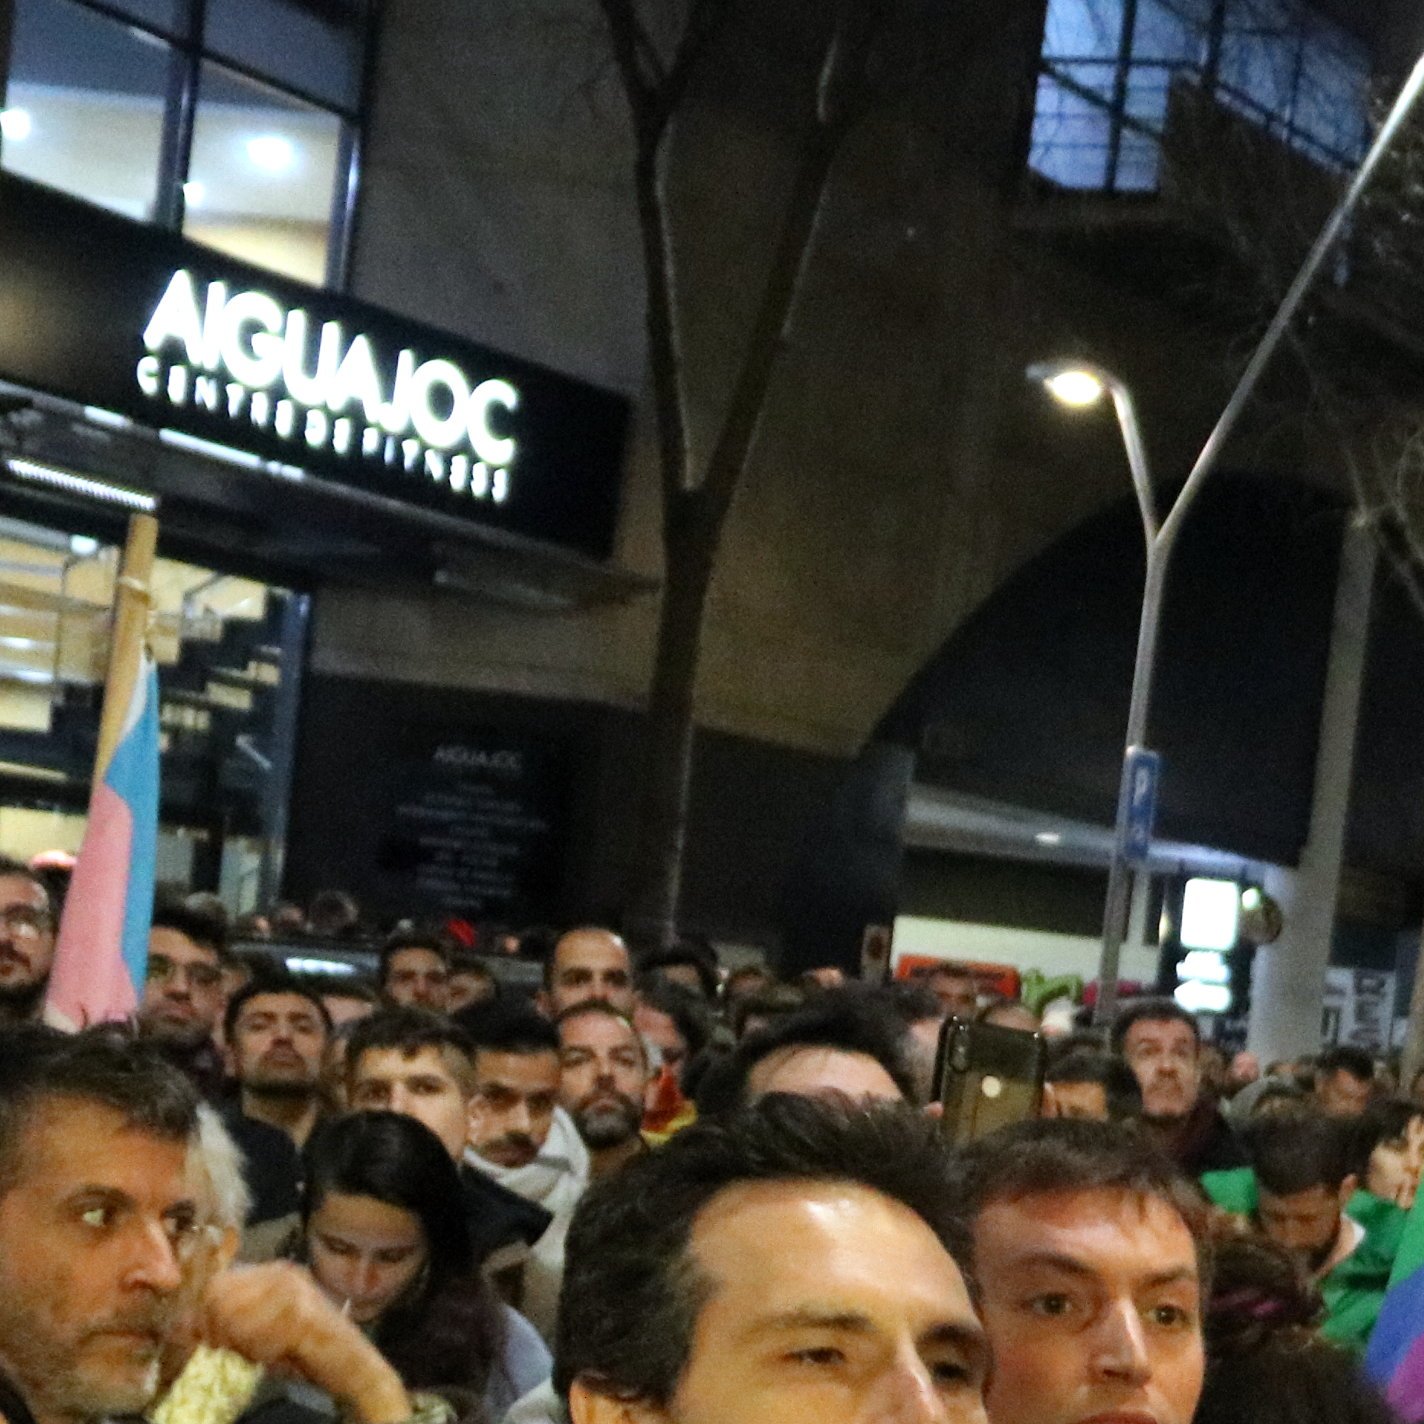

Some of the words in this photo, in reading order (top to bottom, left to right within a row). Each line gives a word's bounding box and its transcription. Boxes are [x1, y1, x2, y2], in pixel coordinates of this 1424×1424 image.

[136, 356, 293, 439] CENTRE
[305, 408, 352, 455] DE
[362, 427, 509, 503] FITNESS
[143, 268, 519, 467] AIGUAJOC
